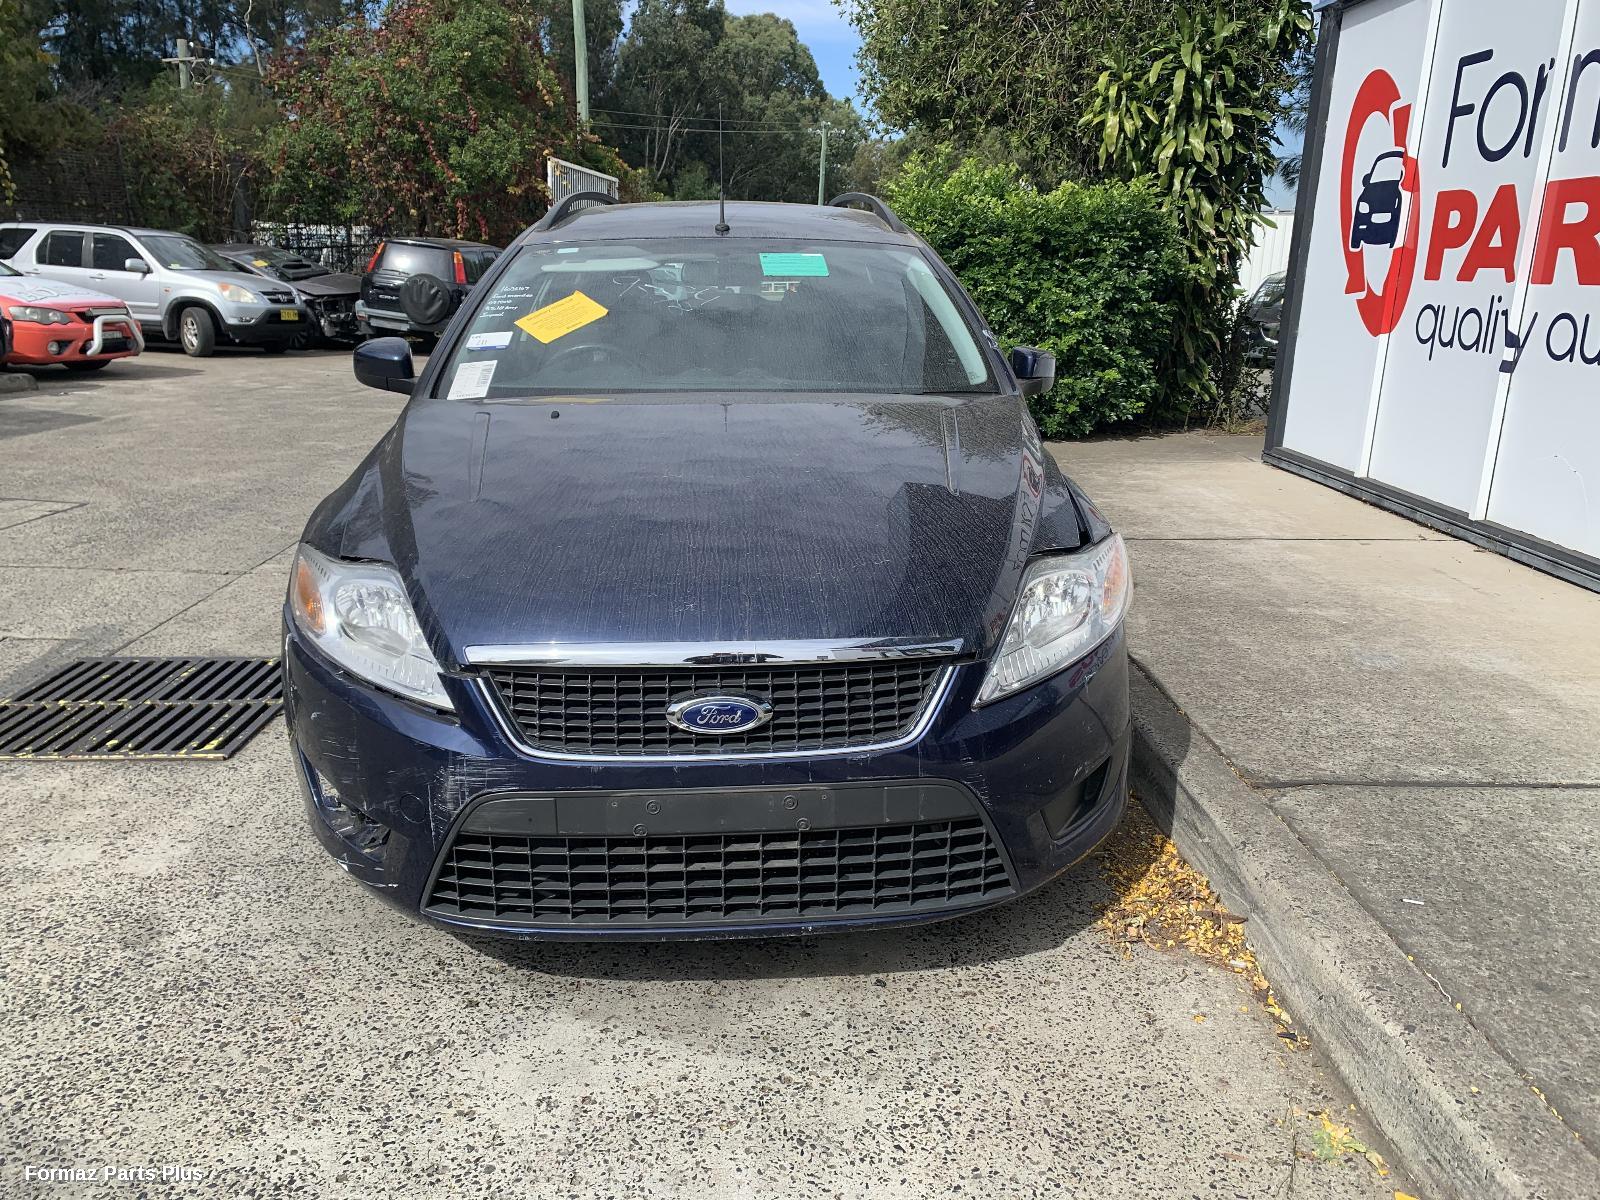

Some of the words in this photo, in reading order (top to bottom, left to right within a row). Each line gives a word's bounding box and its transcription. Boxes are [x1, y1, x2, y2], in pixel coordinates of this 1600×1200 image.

[1423, 176, 1600, 286] PAR
[1415, 295, 1539, 374] qualiy
[696, 705, 742, 724] Ford
